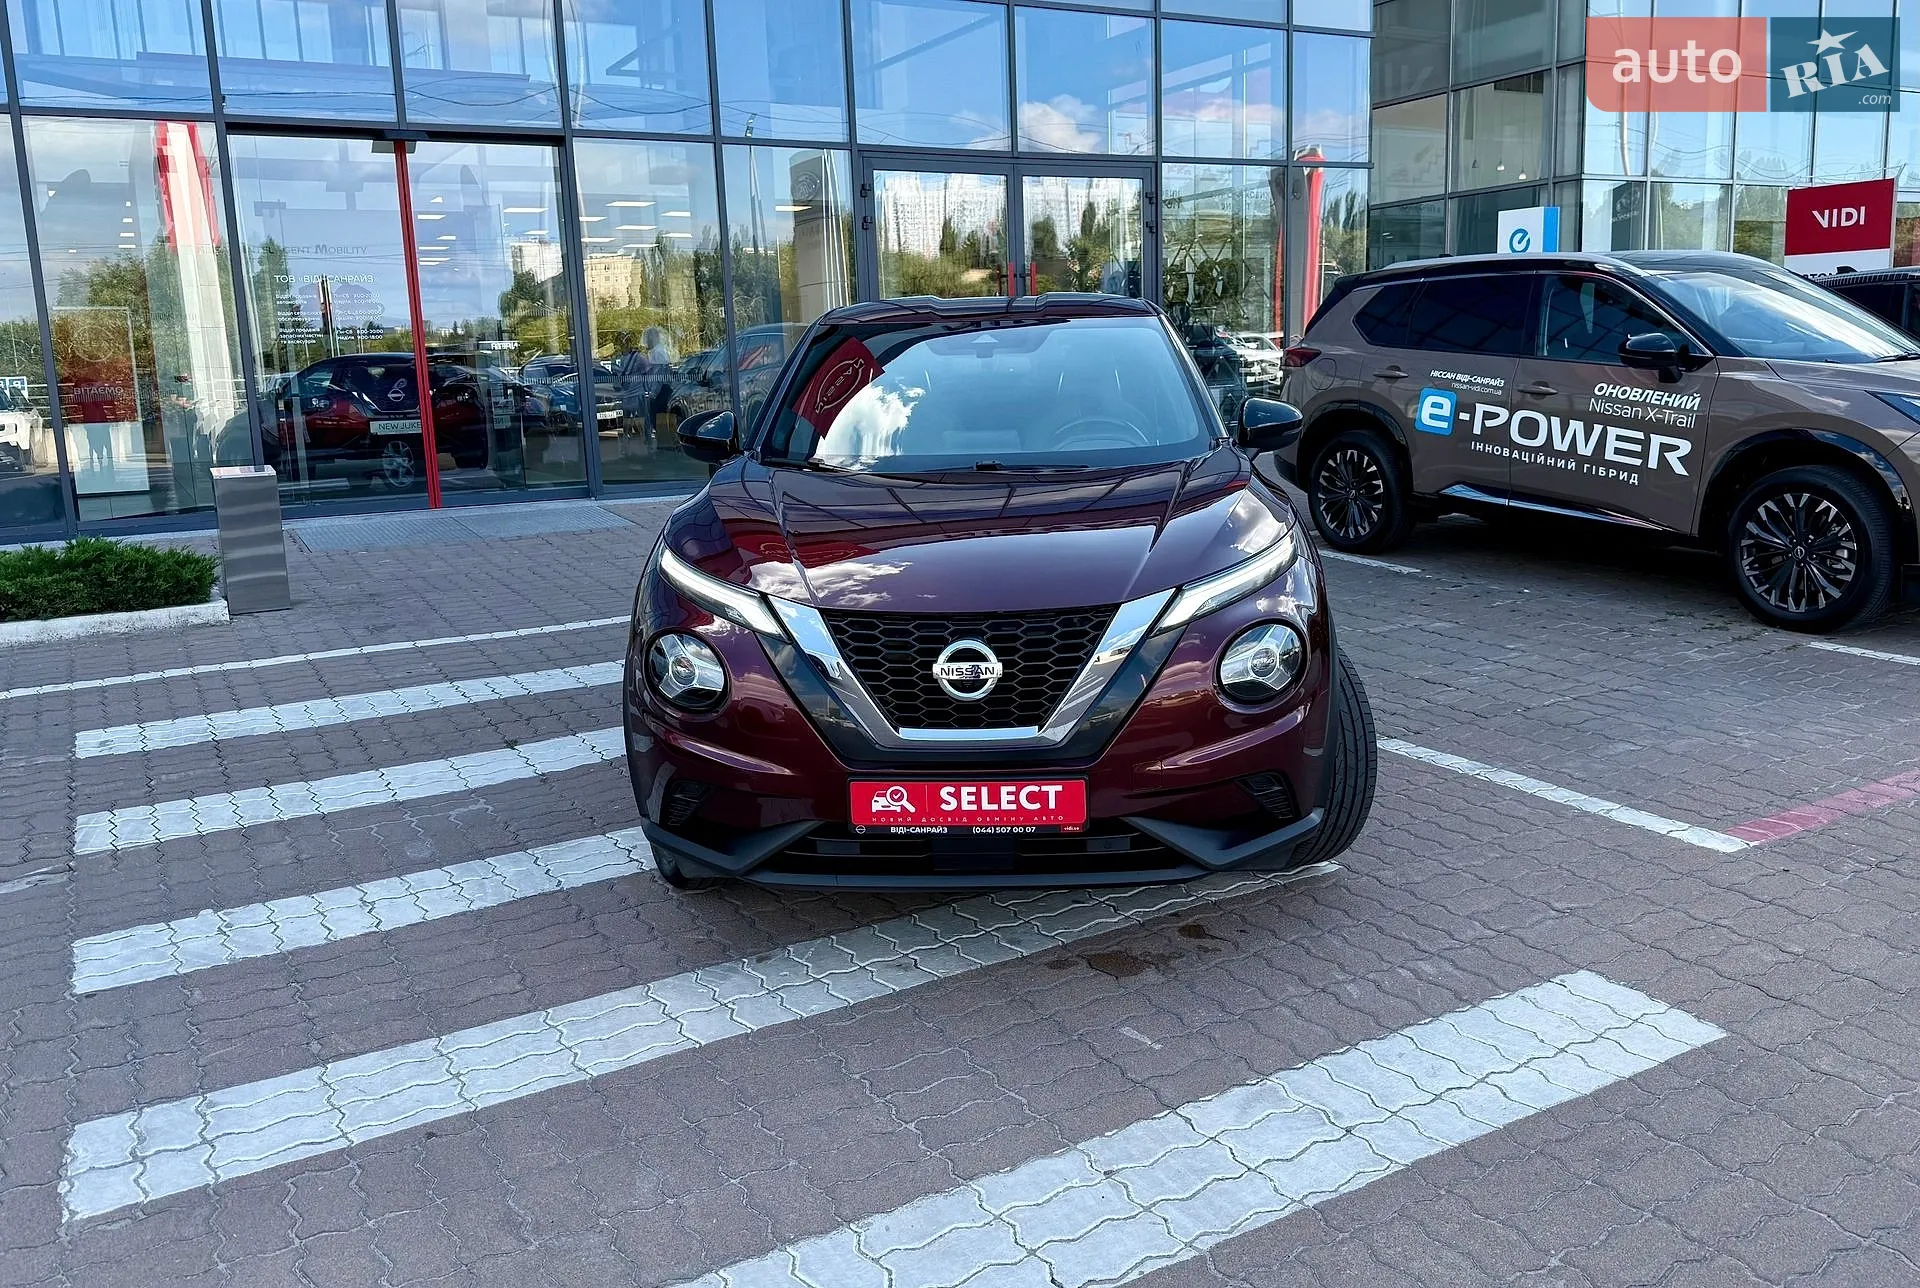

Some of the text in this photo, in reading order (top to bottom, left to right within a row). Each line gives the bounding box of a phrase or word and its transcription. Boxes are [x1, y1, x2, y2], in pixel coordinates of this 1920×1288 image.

[1812, 206, 1866, 228] VIDI
[274, 275, 295, 283] ТОВ
[1594, 382, 1702, 411] ОНОВЛЕНИЙ
[1589, 398, 1697, 429] Nissan X-Trail
[379, 421, 422, 430] NEW JUKE
[1471, 441, 1640, 486] ІННОВАЦІЙНИЙ ГІБРИД
[940, 666, 995, 677] NISSAN
[939, 785, 1063, 811] SELECT
[890, 825, 948, 834] ВІДІ-САНРАЙЗ
[972, 826, 994, 834] (044)
